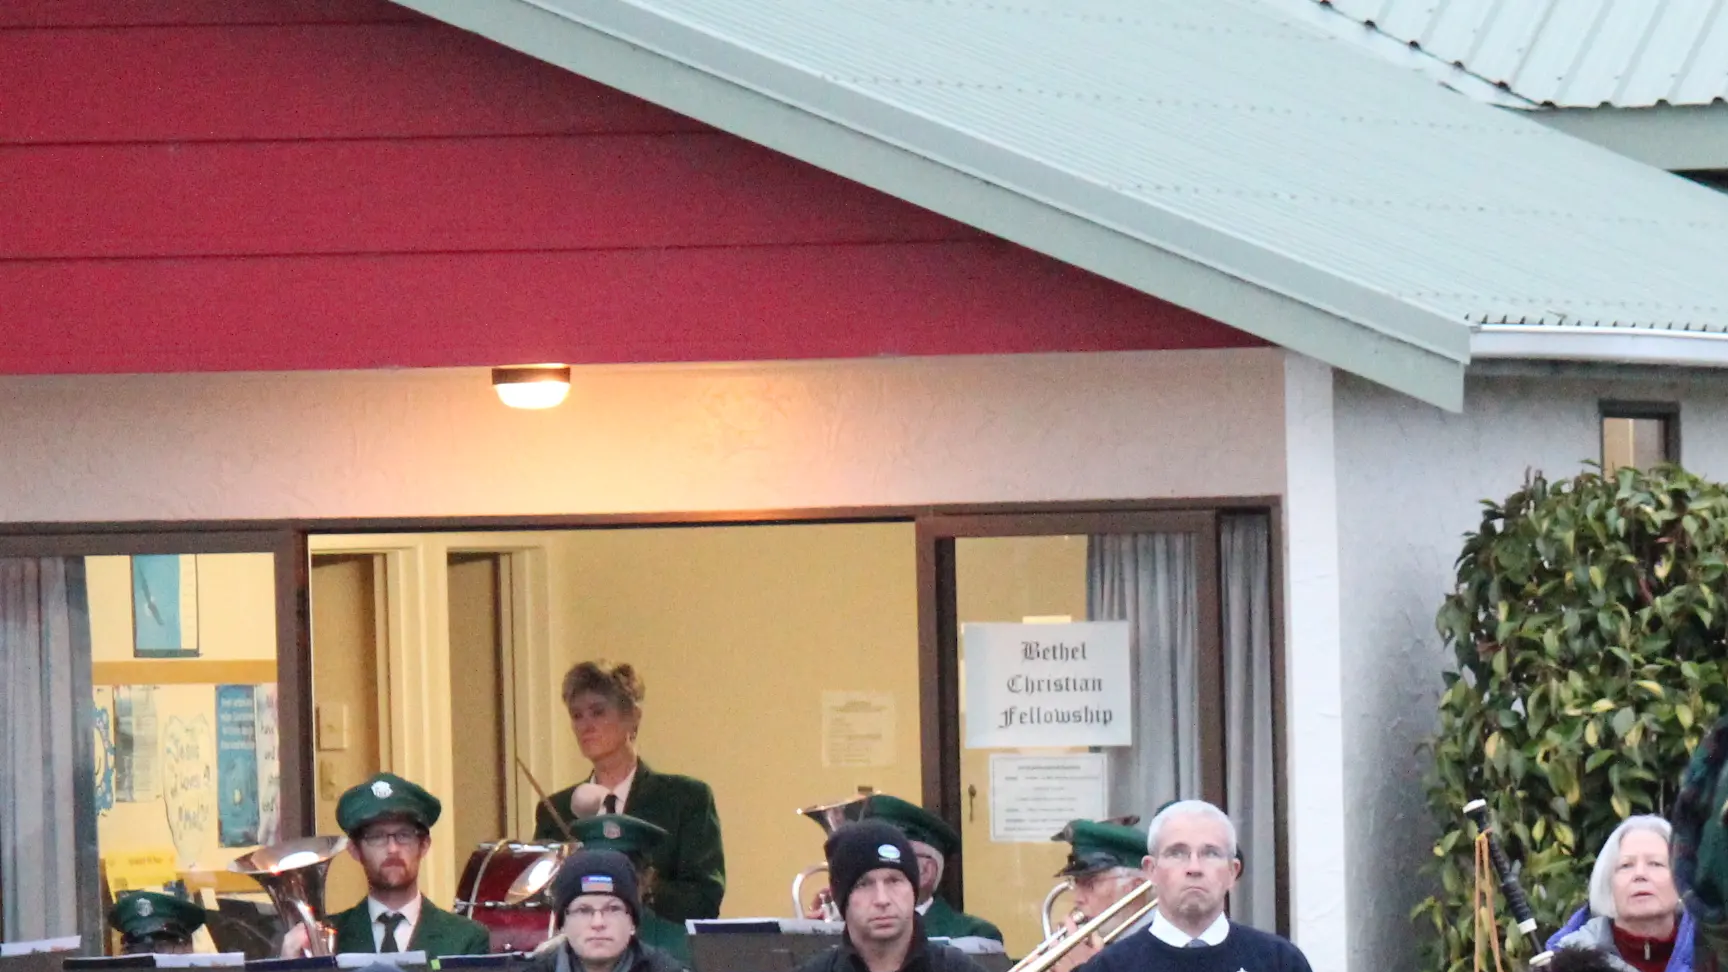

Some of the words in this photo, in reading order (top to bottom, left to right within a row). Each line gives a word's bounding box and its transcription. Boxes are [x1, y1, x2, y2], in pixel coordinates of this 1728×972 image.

[1021, 641, 1087, 663] Bethel
[1006, 673, 1103, 695] Christian
[997, 705, 1113, 729] Fellowship
